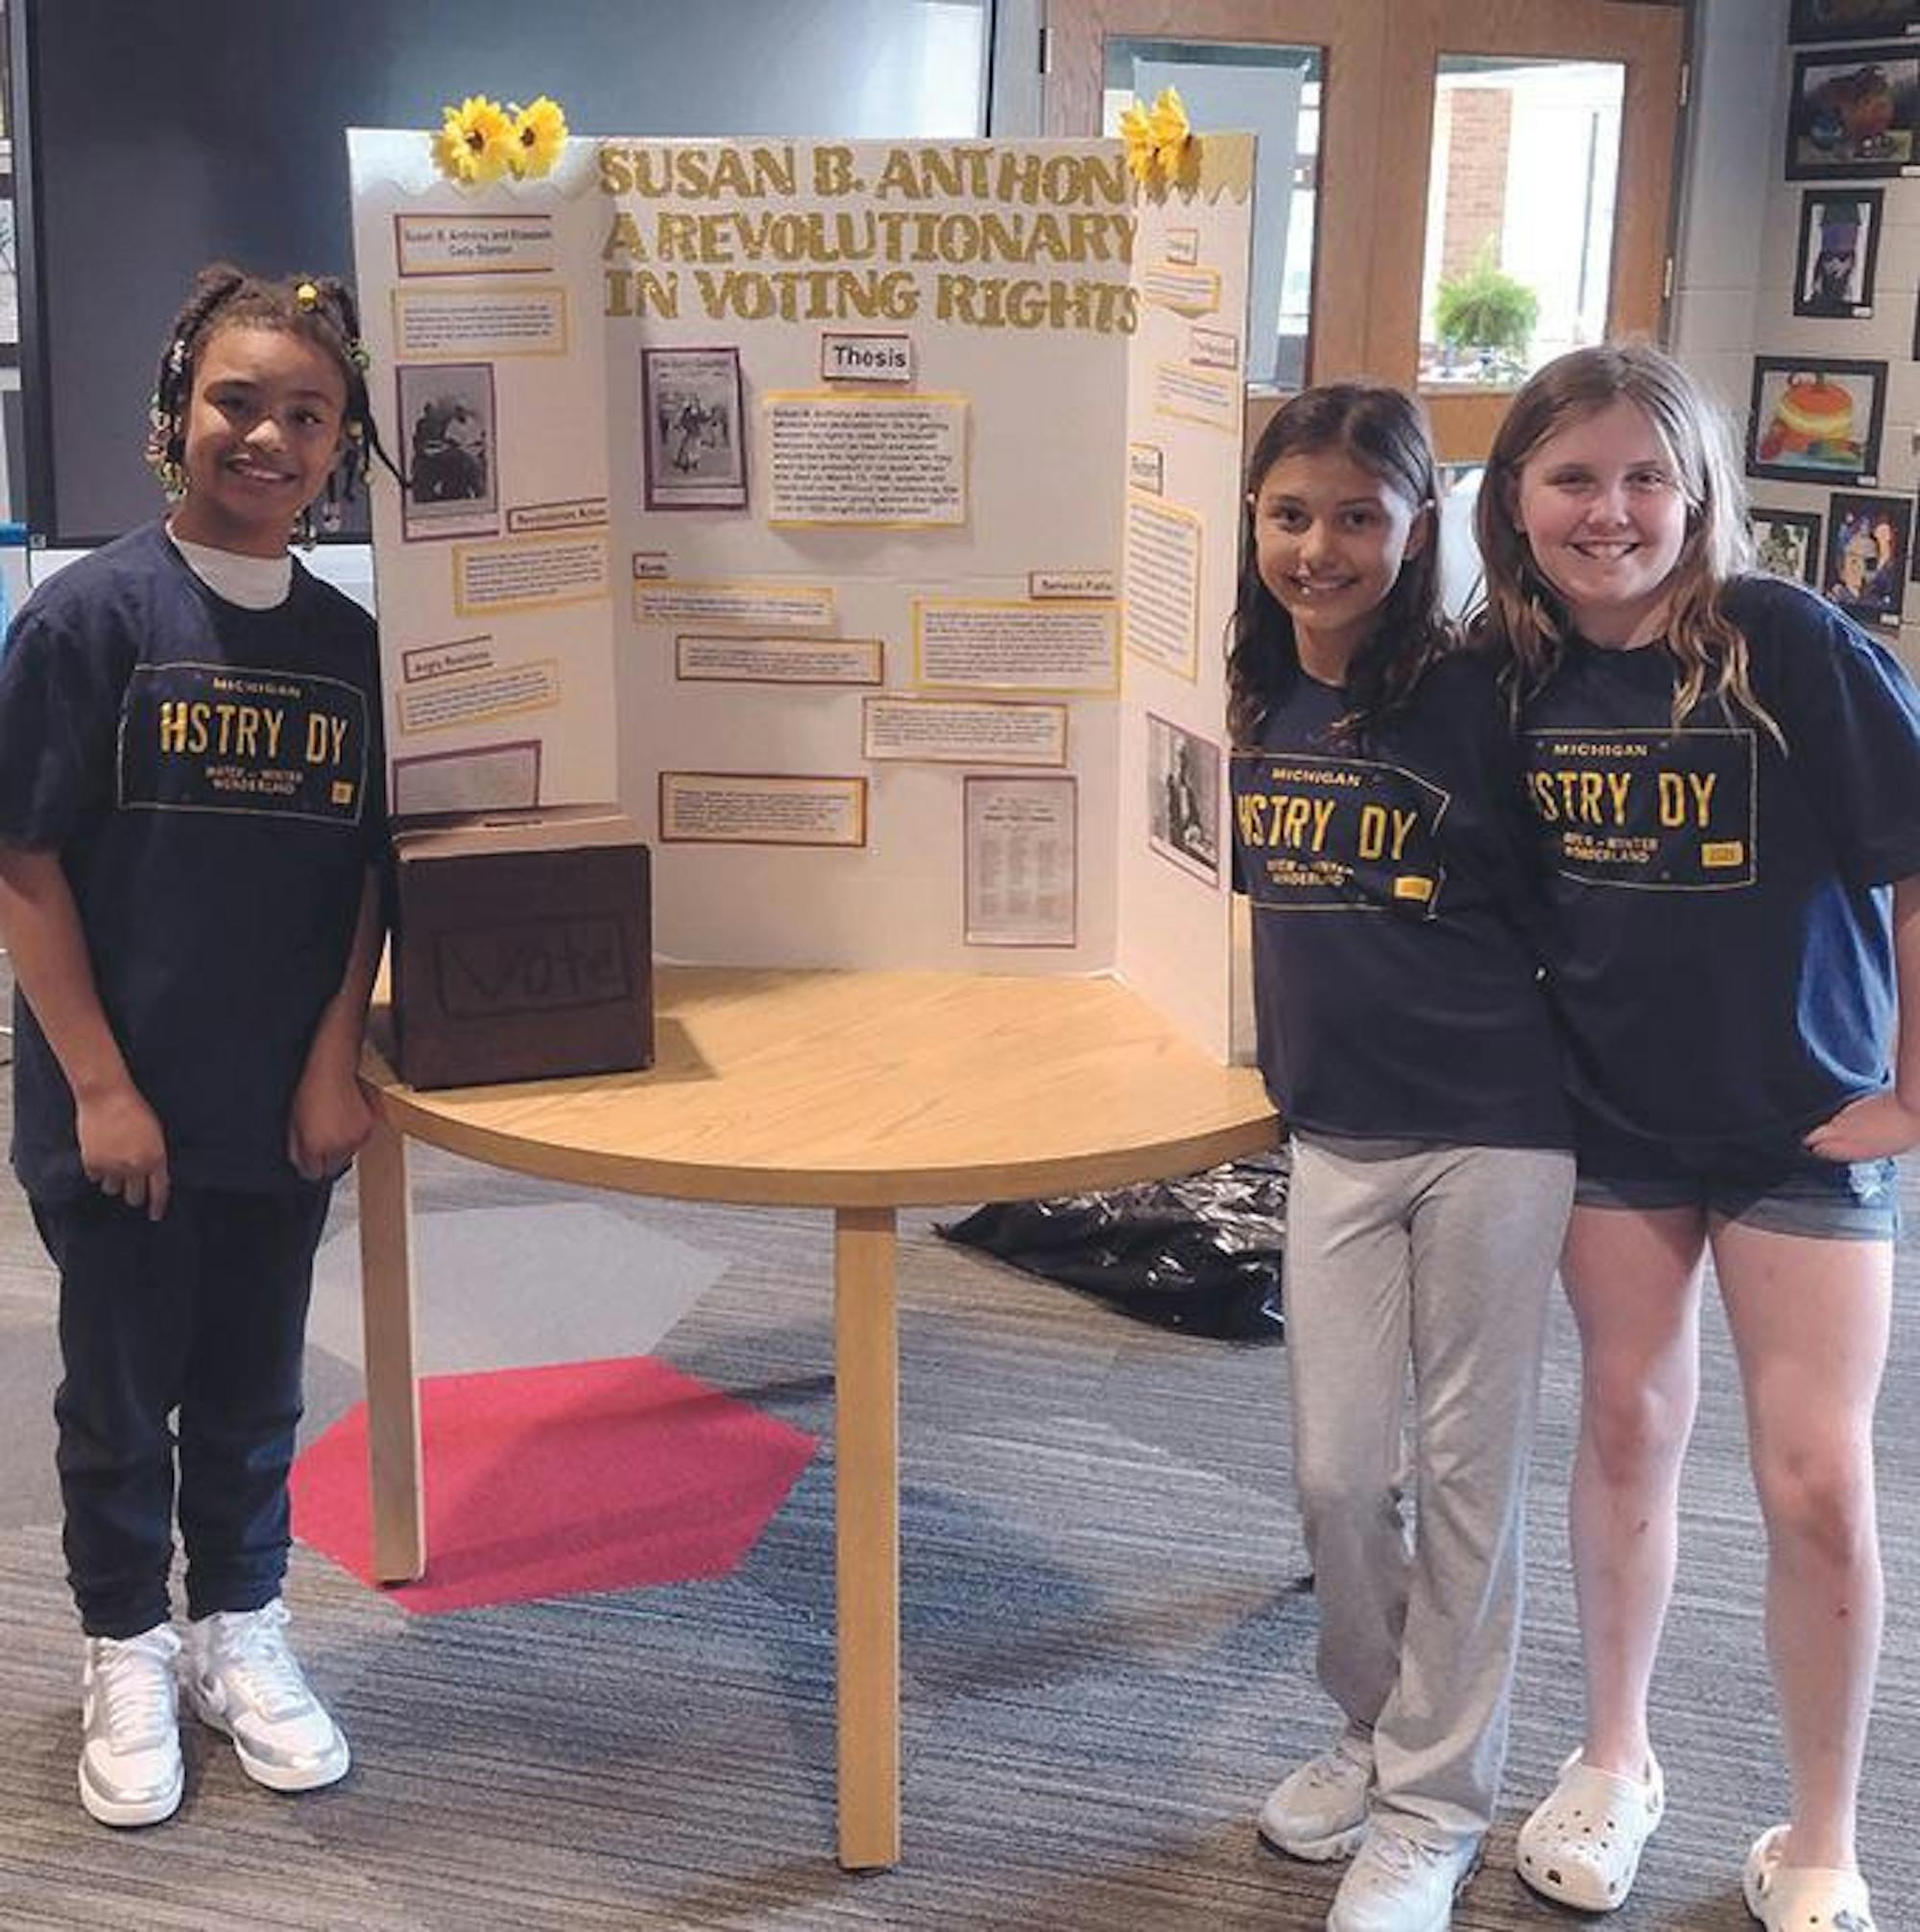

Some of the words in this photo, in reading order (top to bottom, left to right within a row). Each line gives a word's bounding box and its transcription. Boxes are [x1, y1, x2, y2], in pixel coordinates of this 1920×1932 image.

[599, 145, 797, 201] SUSAN
[812, 147, 863, 196] B.
[876, 146, 1139, 207] ANTHON
[601, 211, 648, 263] A
[657, 210, 1140, 265] REVOLUTIONARY
[604, 270, 679, 319] IN
[695, 268, 921, 322] VOTING
[936, 274, 1140, 335] RIGHTS
[213, 677, 301, 699] MICHIGAN
[159, 701, 284, 760] HSTRY
[306, 712, 348, 764] DY
[1552, 744, 1648, 758] MICHIGAN
[1271, 767, 1362, 787] MICHIGAN
[1526, 771, 1632, 826] STRY
[1657, 772, 1716, 828] DY
[1357, 804, 1419, 861] DY
